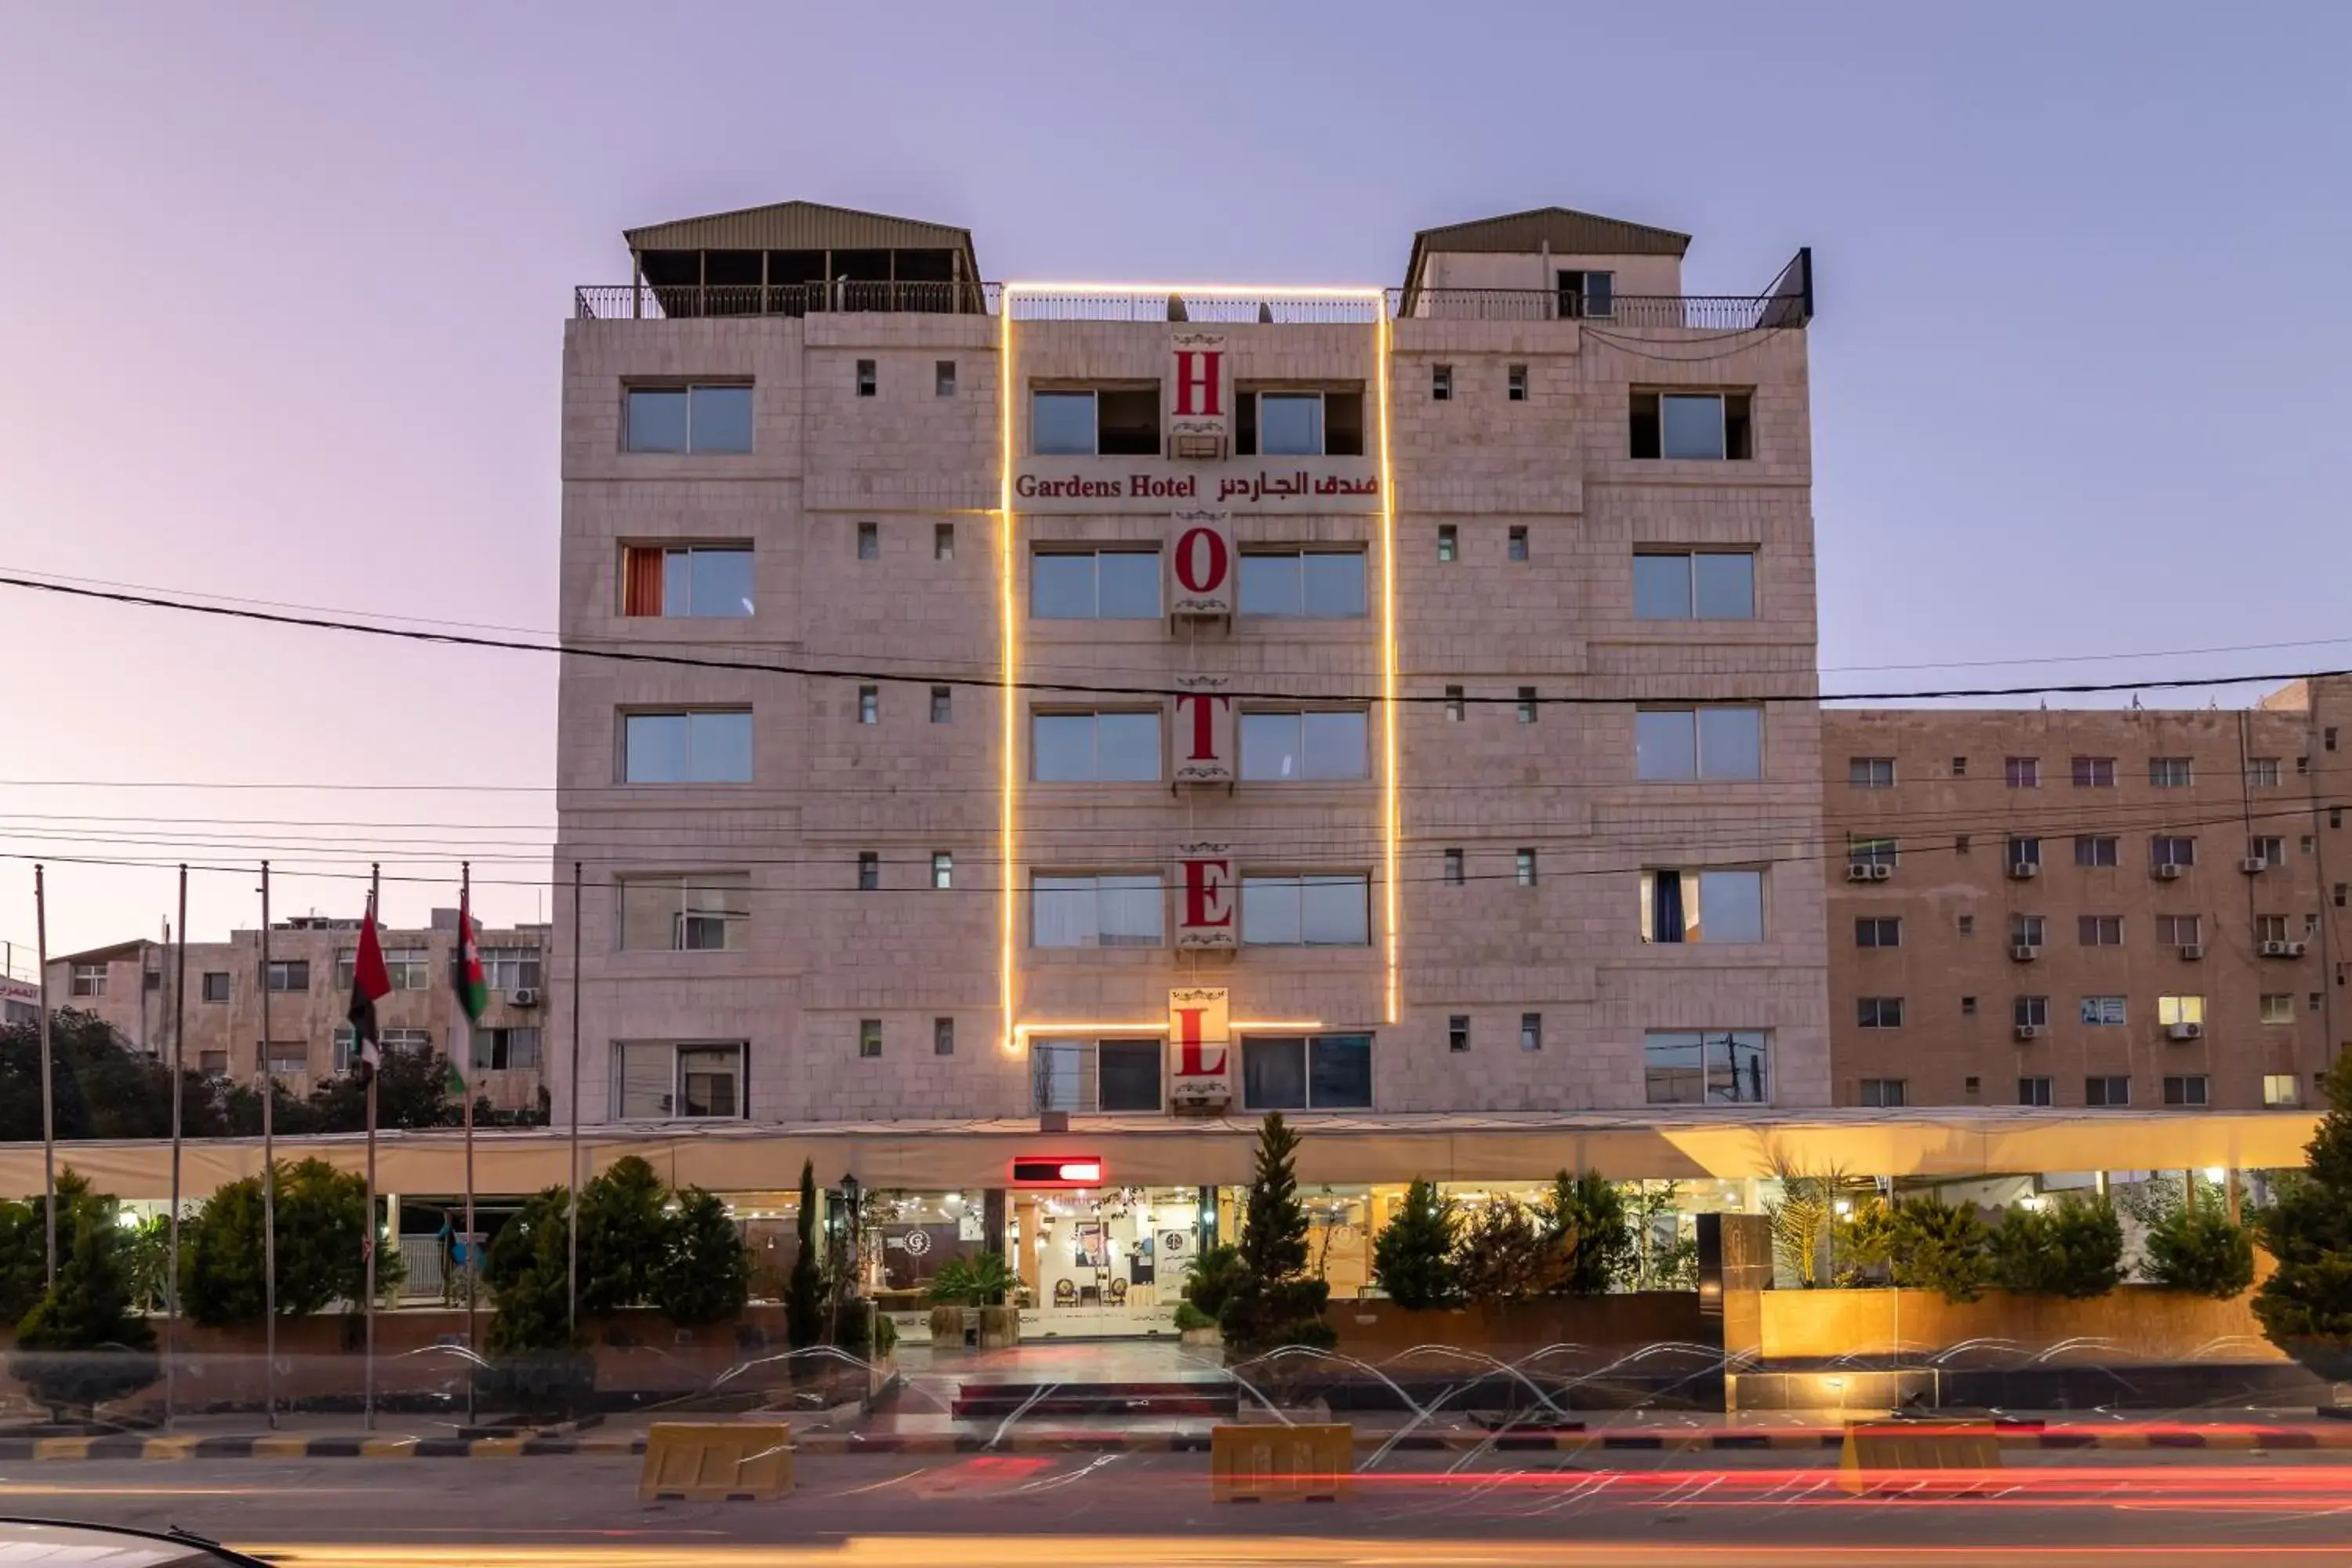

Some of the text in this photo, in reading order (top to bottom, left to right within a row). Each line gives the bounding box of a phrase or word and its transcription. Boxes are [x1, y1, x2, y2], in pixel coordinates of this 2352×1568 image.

[1016, 474, 1196, 498] Gardens Hotel
[1217, 470, 1378, 503] فندق الجاردنز
